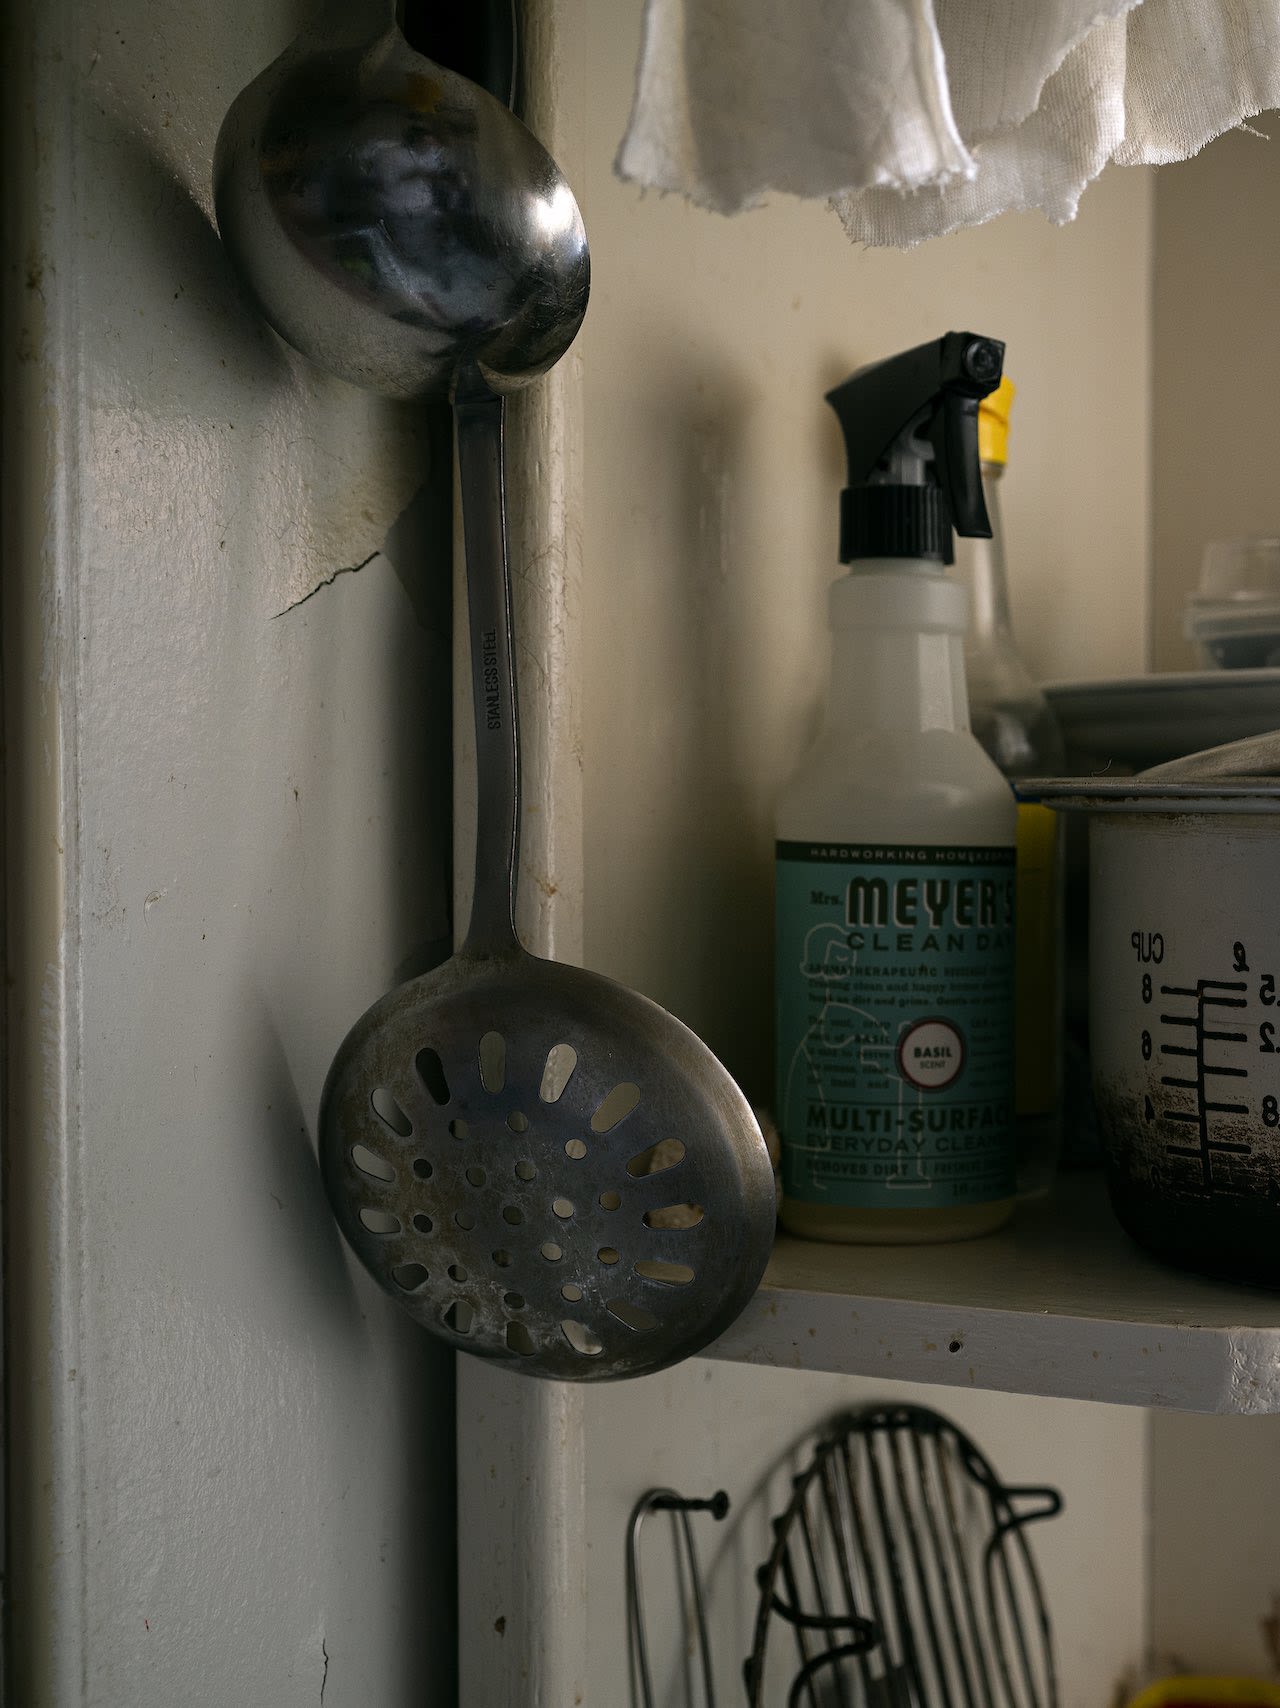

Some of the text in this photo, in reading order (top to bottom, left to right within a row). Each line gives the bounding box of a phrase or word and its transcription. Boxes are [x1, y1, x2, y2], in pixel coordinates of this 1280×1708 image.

[482, 628, 498, 666] STEEL
[810, 848, 928, 861] HARDWORKING
[809, 890, 844, 905] Mrs.
[846, 932, 965, 952] CLEAN
[913, 1046, 953, 1059] BASIL
[919, 1060, 946, 1069] SCENT
[806, 1133, 928, 1153] EVERYDAY
[806, 1159, 908, 1177] REMOVES DIRT
